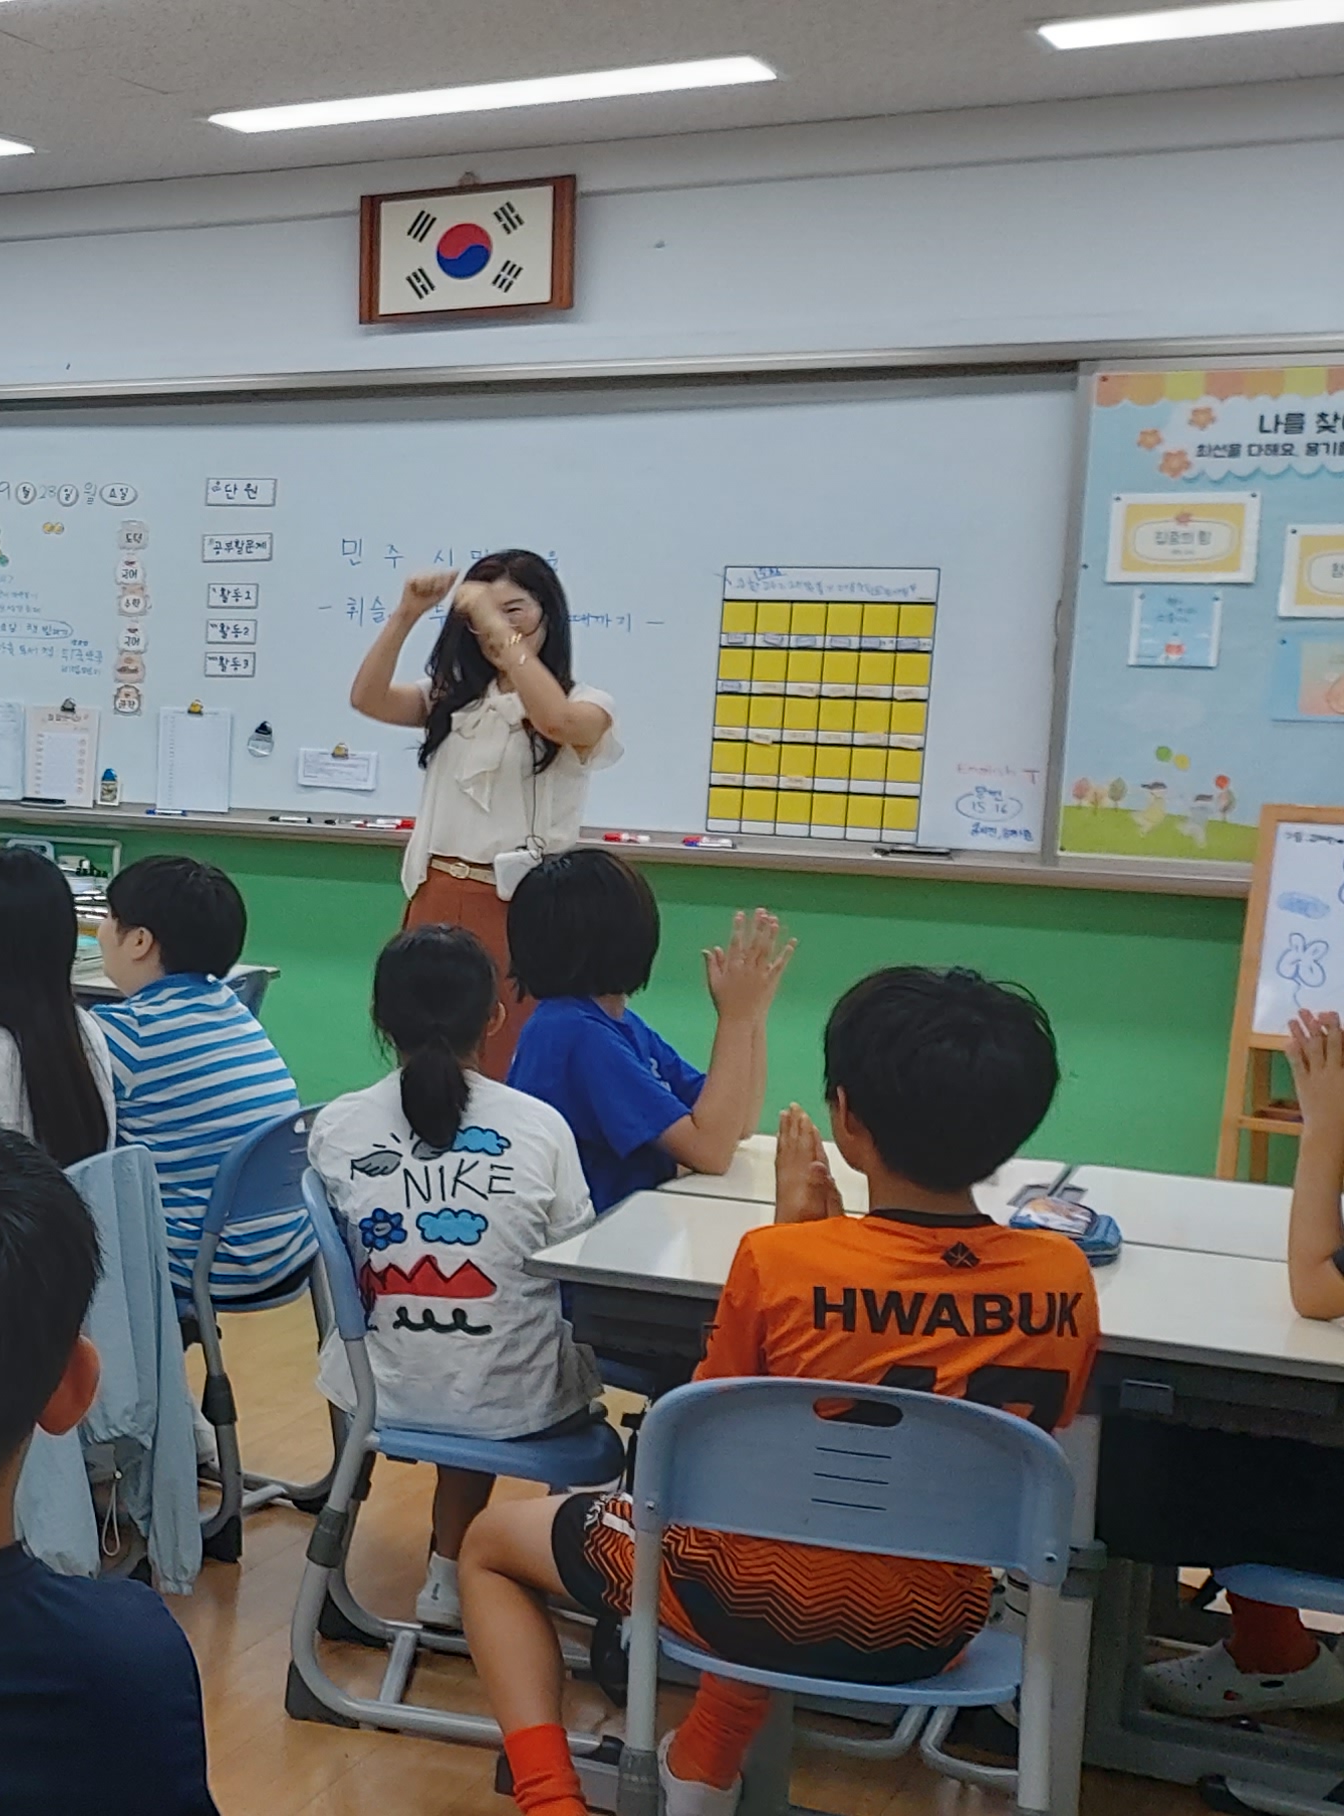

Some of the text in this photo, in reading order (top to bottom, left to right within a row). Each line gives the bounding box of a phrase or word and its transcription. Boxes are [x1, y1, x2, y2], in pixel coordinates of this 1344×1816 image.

[1258, 411, 1344, 435] 나를 찾
[1196, 443, 1242, 458] 최선을
[122, 569, 138, 579] 국어
[124, 636, 141, 647] 국어
[403, 1158, 516, 1209] NIKE
[812, 1285, 1083, 1338] HWABUK
